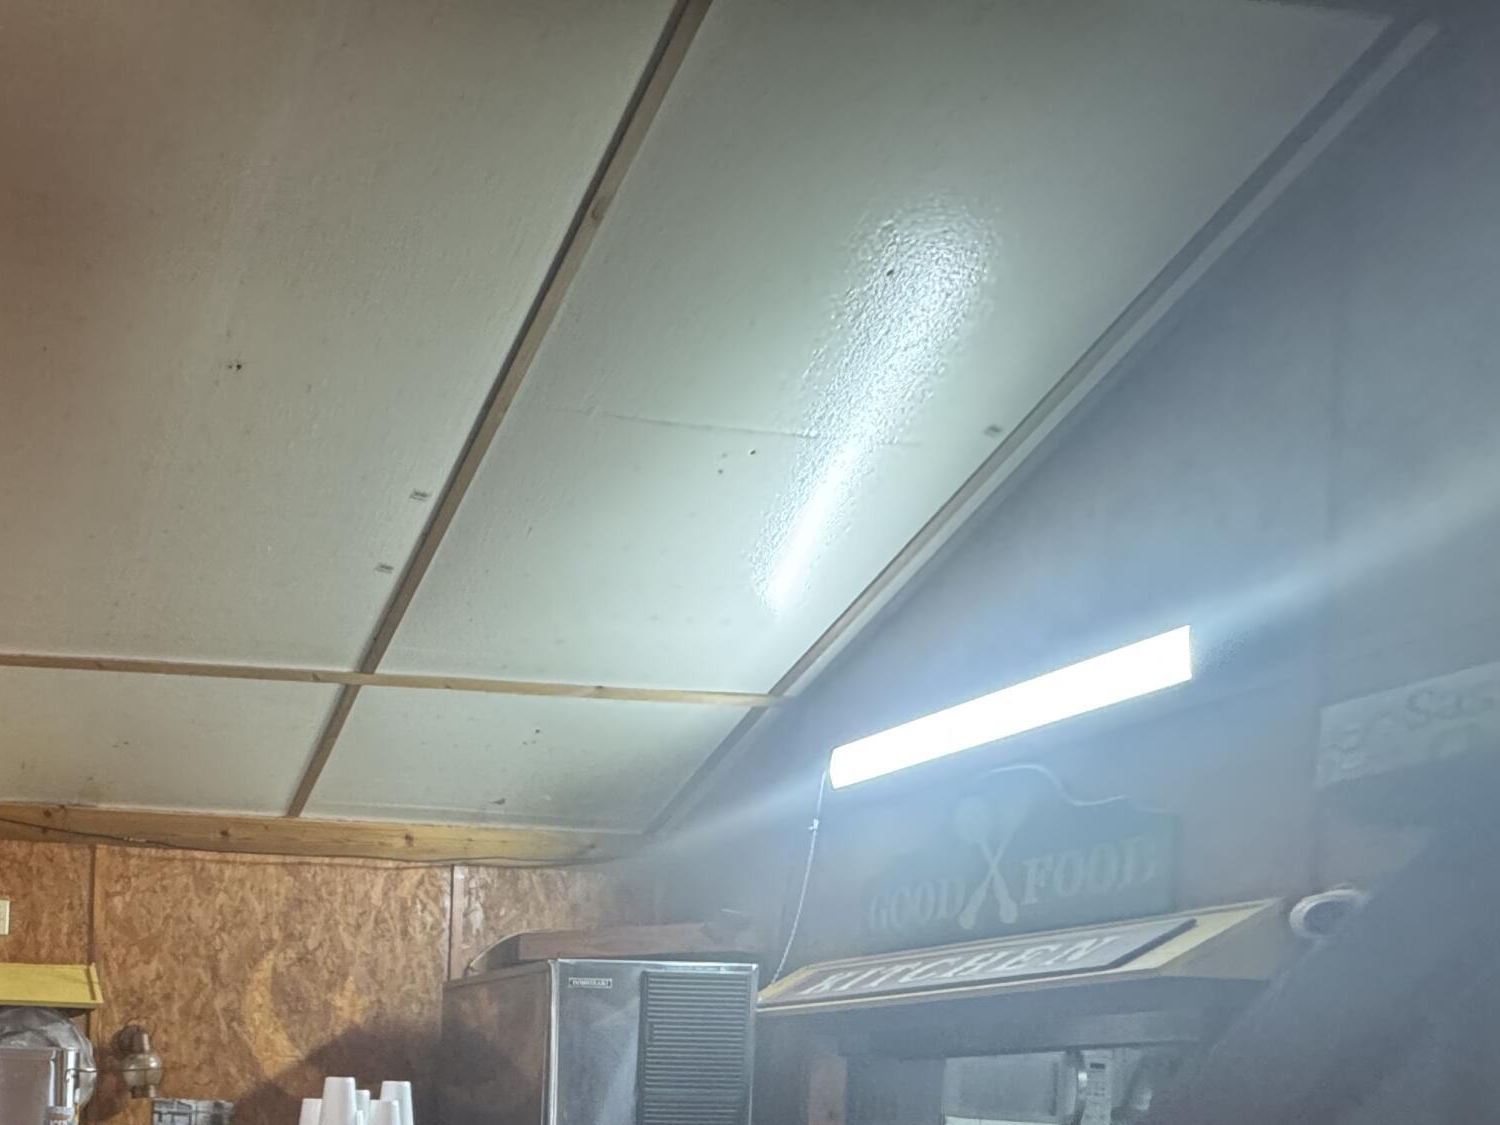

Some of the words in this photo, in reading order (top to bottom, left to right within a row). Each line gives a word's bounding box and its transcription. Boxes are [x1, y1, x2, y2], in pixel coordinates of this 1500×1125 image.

[869, 878, 966, 929] GOOD
[1019, 834, 1160, 906] FOOD
[801, 936, 1118, 995] KITCHEN
